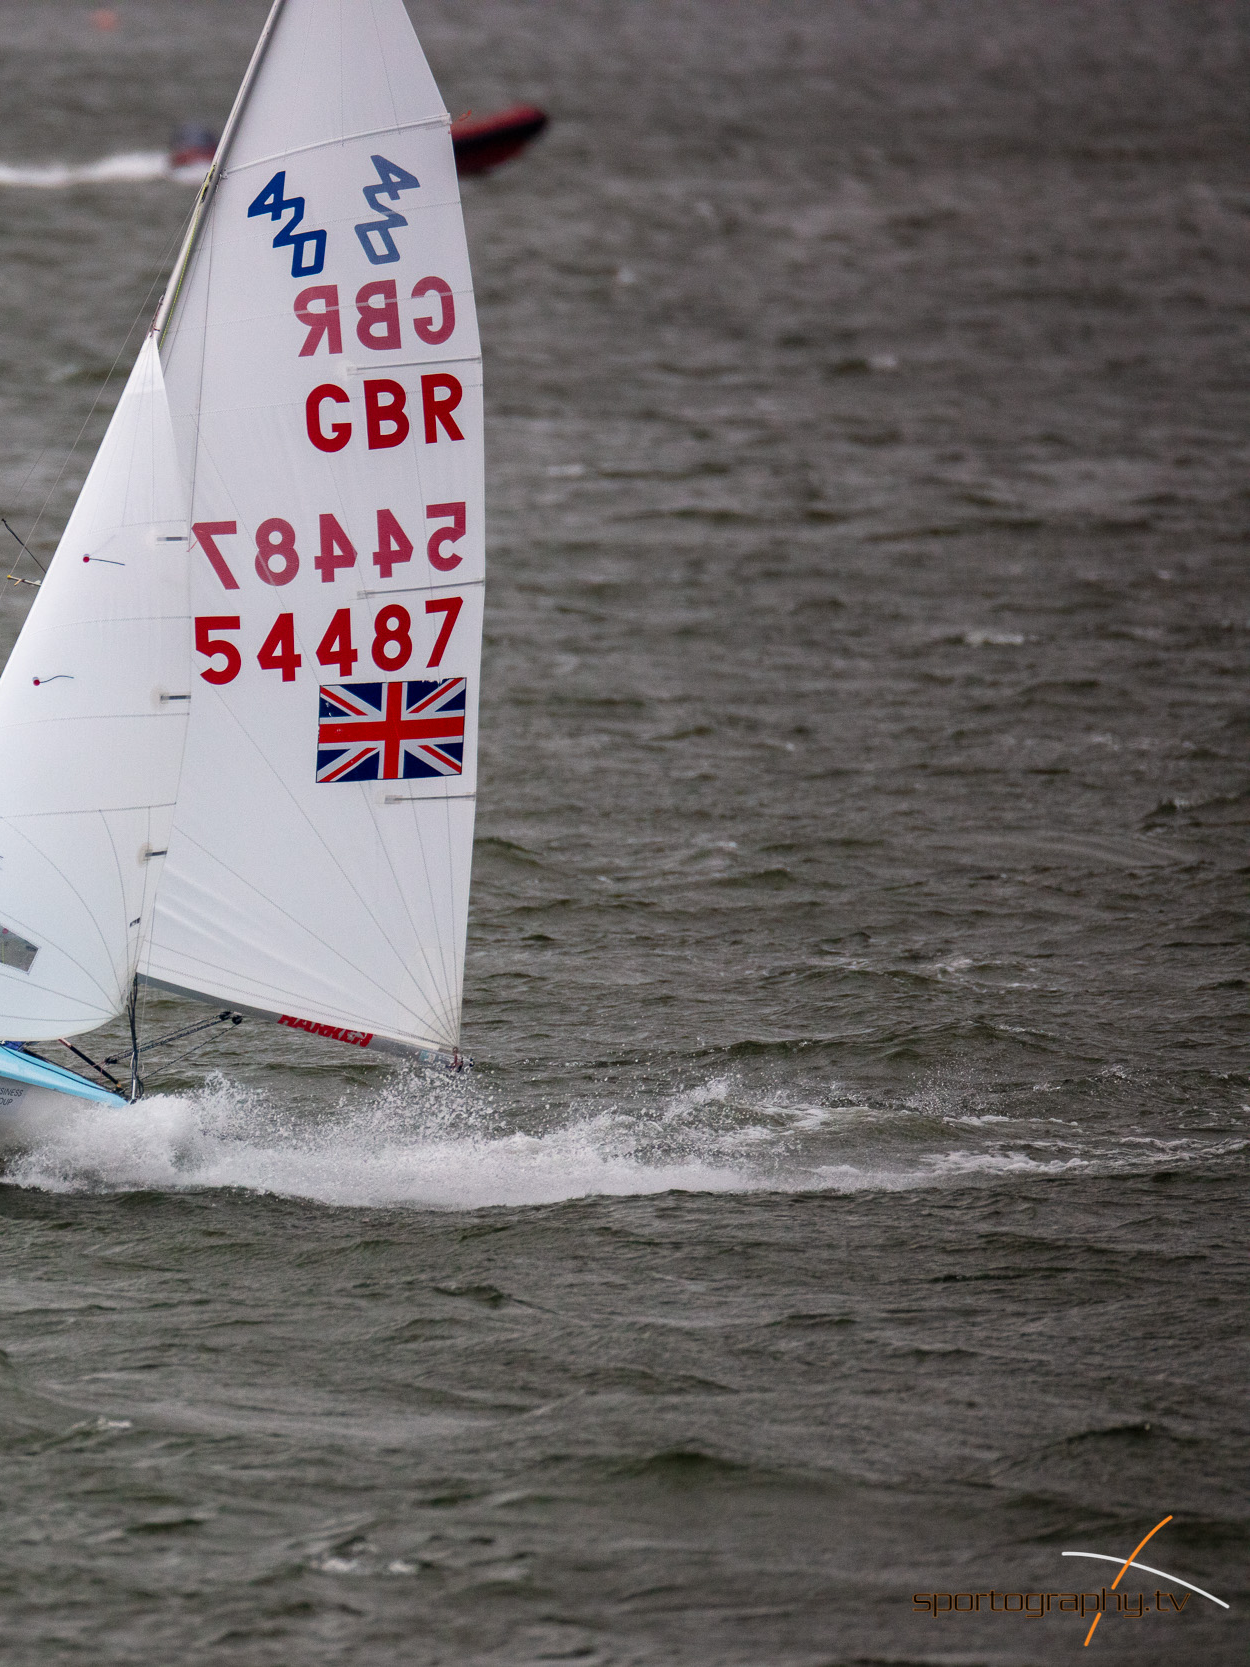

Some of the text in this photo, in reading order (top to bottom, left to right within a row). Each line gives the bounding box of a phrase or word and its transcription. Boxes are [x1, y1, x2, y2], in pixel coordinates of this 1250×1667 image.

[247, 170, 327, 278] 420
[305, 373, 465, 453] GBR
[194, 596, 464, 685] 54487
